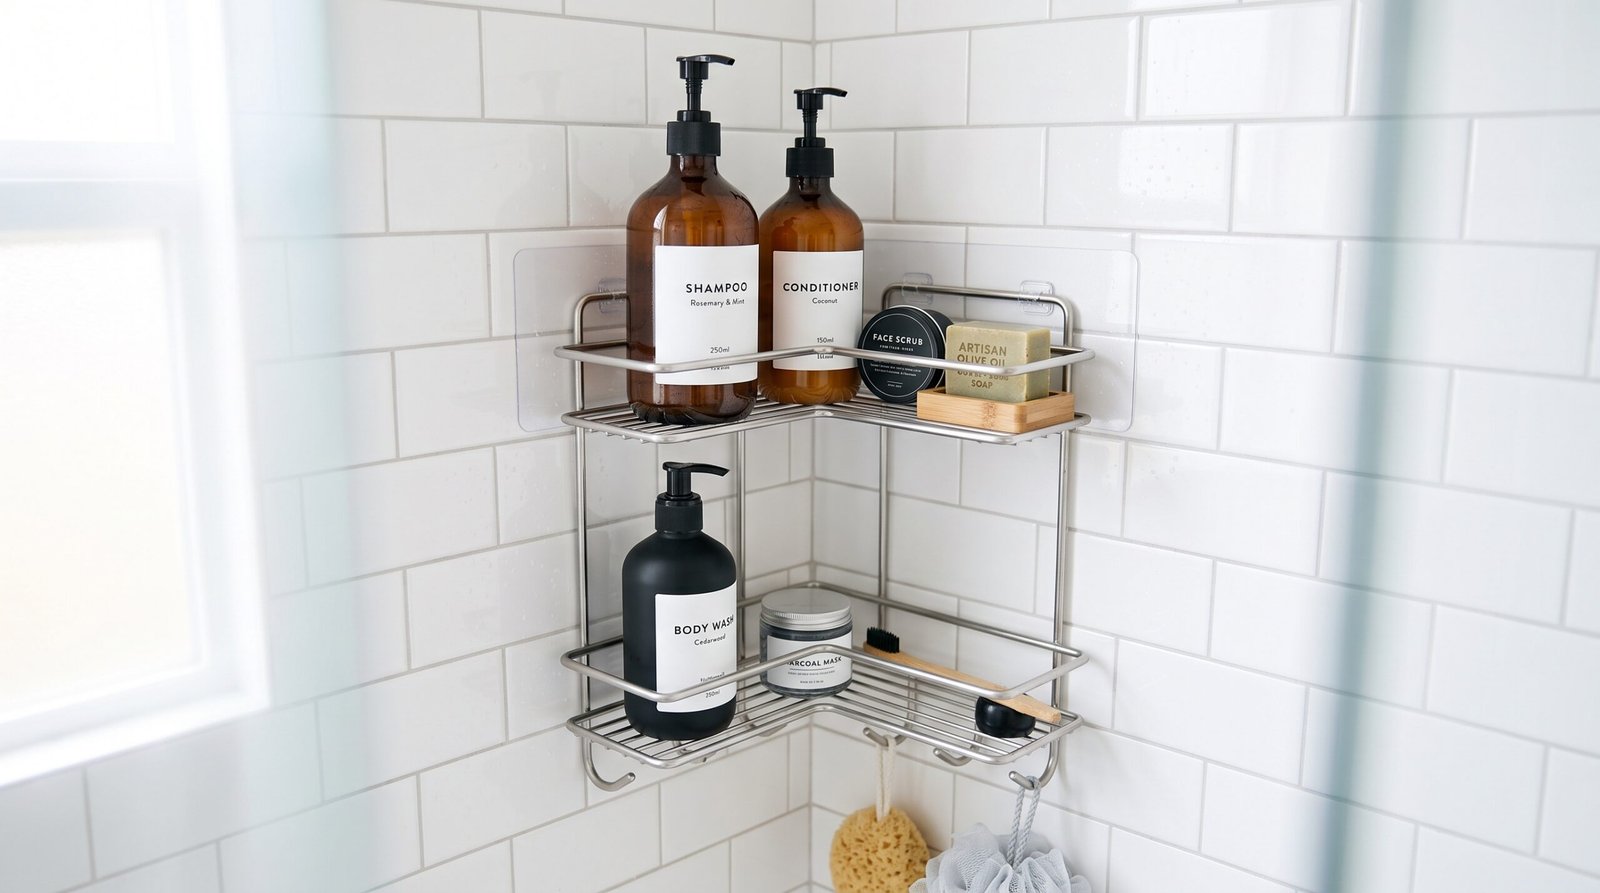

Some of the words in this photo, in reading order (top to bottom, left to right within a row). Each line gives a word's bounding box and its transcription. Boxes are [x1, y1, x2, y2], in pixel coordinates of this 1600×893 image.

[686, 282, 748, 293] SHAMPOO
[783, 281, 859, 292] CONDITIONER
[690, 299, 724, 308] Rosemary
[873, 333, 894, 342] FACE
[896, 335, 923, 346] SCRUB
[958, 342, 1007, 357] ARTISAN
[957, 354, 987, 365] OLIVE
[971, 379, 993, 389] SOAP
[674, 623, 709, 635] BODY
[712, 614, 734, 631] WASH
[694, 633, 726, 646] Cedarwood
[787, 659, 821, 667] ARCOAL
[823, 656, 842, 665] MASK
